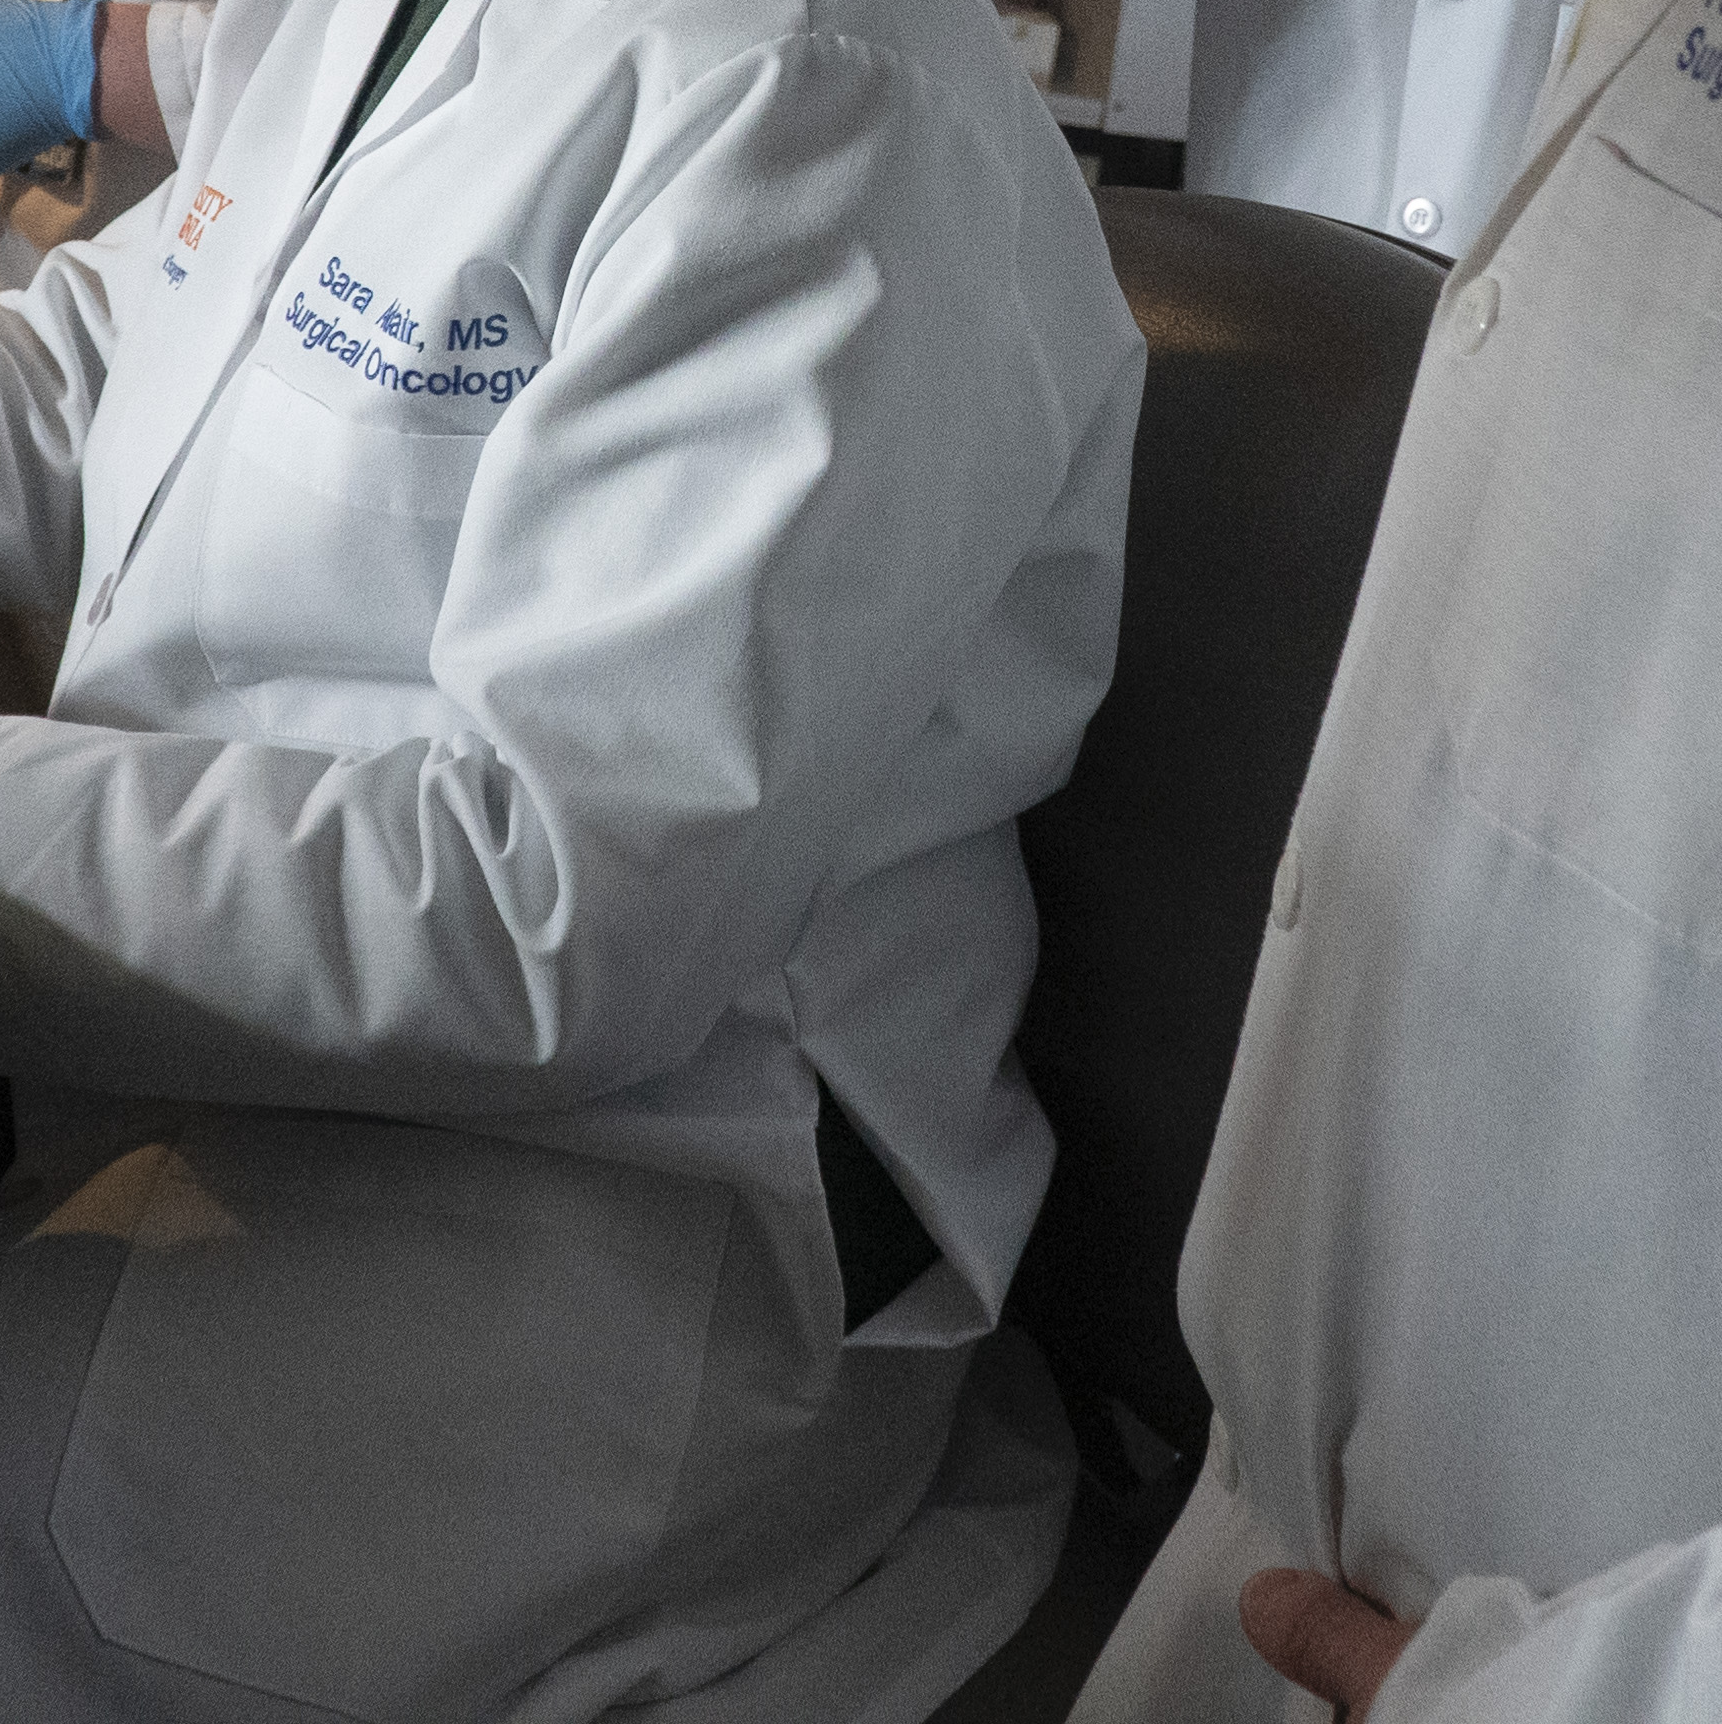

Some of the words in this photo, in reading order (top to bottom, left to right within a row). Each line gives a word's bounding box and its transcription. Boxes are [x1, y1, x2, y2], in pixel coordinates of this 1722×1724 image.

[285, 291, 371, 370] Surgical
[364, 346, 542, 405] Oncology
[319, 257, 375, 315] Sara
[446, 313, 509, 352] MS
